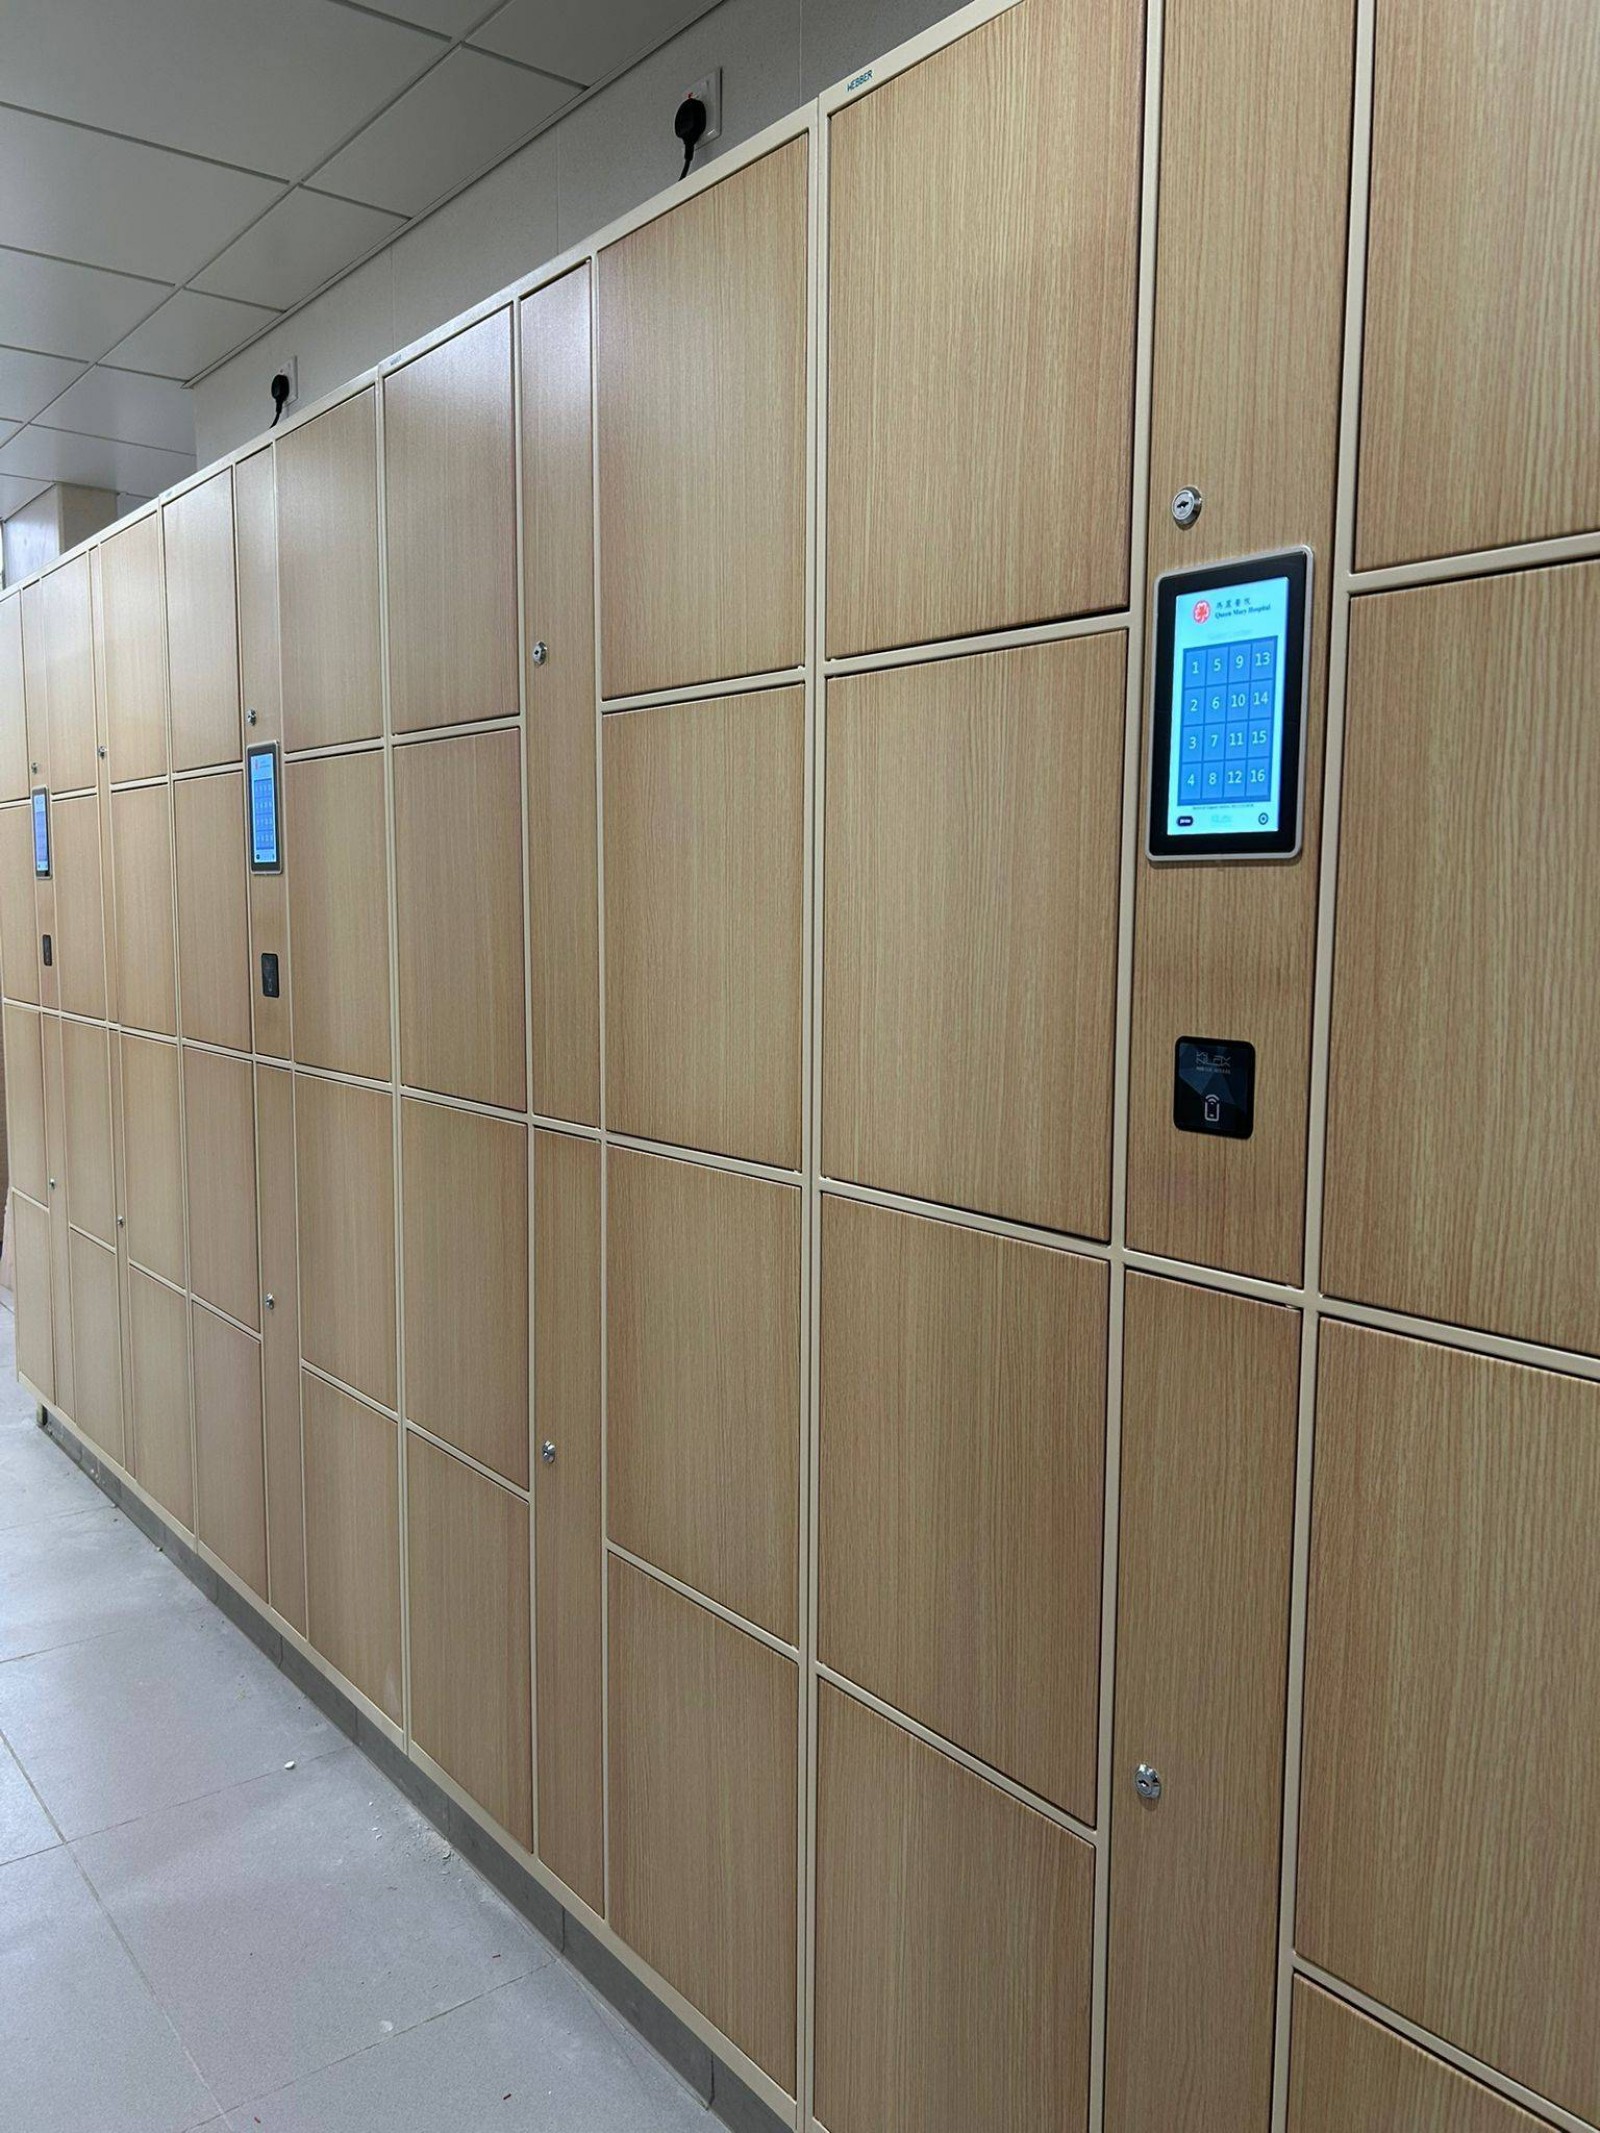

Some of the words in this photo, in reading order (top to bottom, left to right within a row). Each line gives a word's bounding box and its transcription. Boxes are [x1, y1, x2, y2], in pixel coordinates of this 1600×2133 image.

[1215, 611, 1232, 619] Queen
[1233, 608, 1247, 616] Mary
[1248, 603, 1271, 614] Hospital
[1192, 661, 1199, 674] 1
[1213, 658, 1221, 672] 5
[1235, 655, 1244, 669] 9
[1255, 652, 1271, 667] 13
[1190, 699, 1198, 712] 2
[1211, 696, 1220, 710] 6
[1231, 693, 1246, 708] 10
[1253, 691, 1269, 706] 14
[1189, 736, 1197, 749] 3
[1211, 734, 1219, 747] 7
[1229, 732, 1244, 746] 11
[1252, 730, 1267, 744] 15
[1187, 773, 1195, 786] 4
[1208, 772, 1217, 785] 8
[1227, 770, 1242, 784] 12
[1250, 769, 1265, 783] 16
